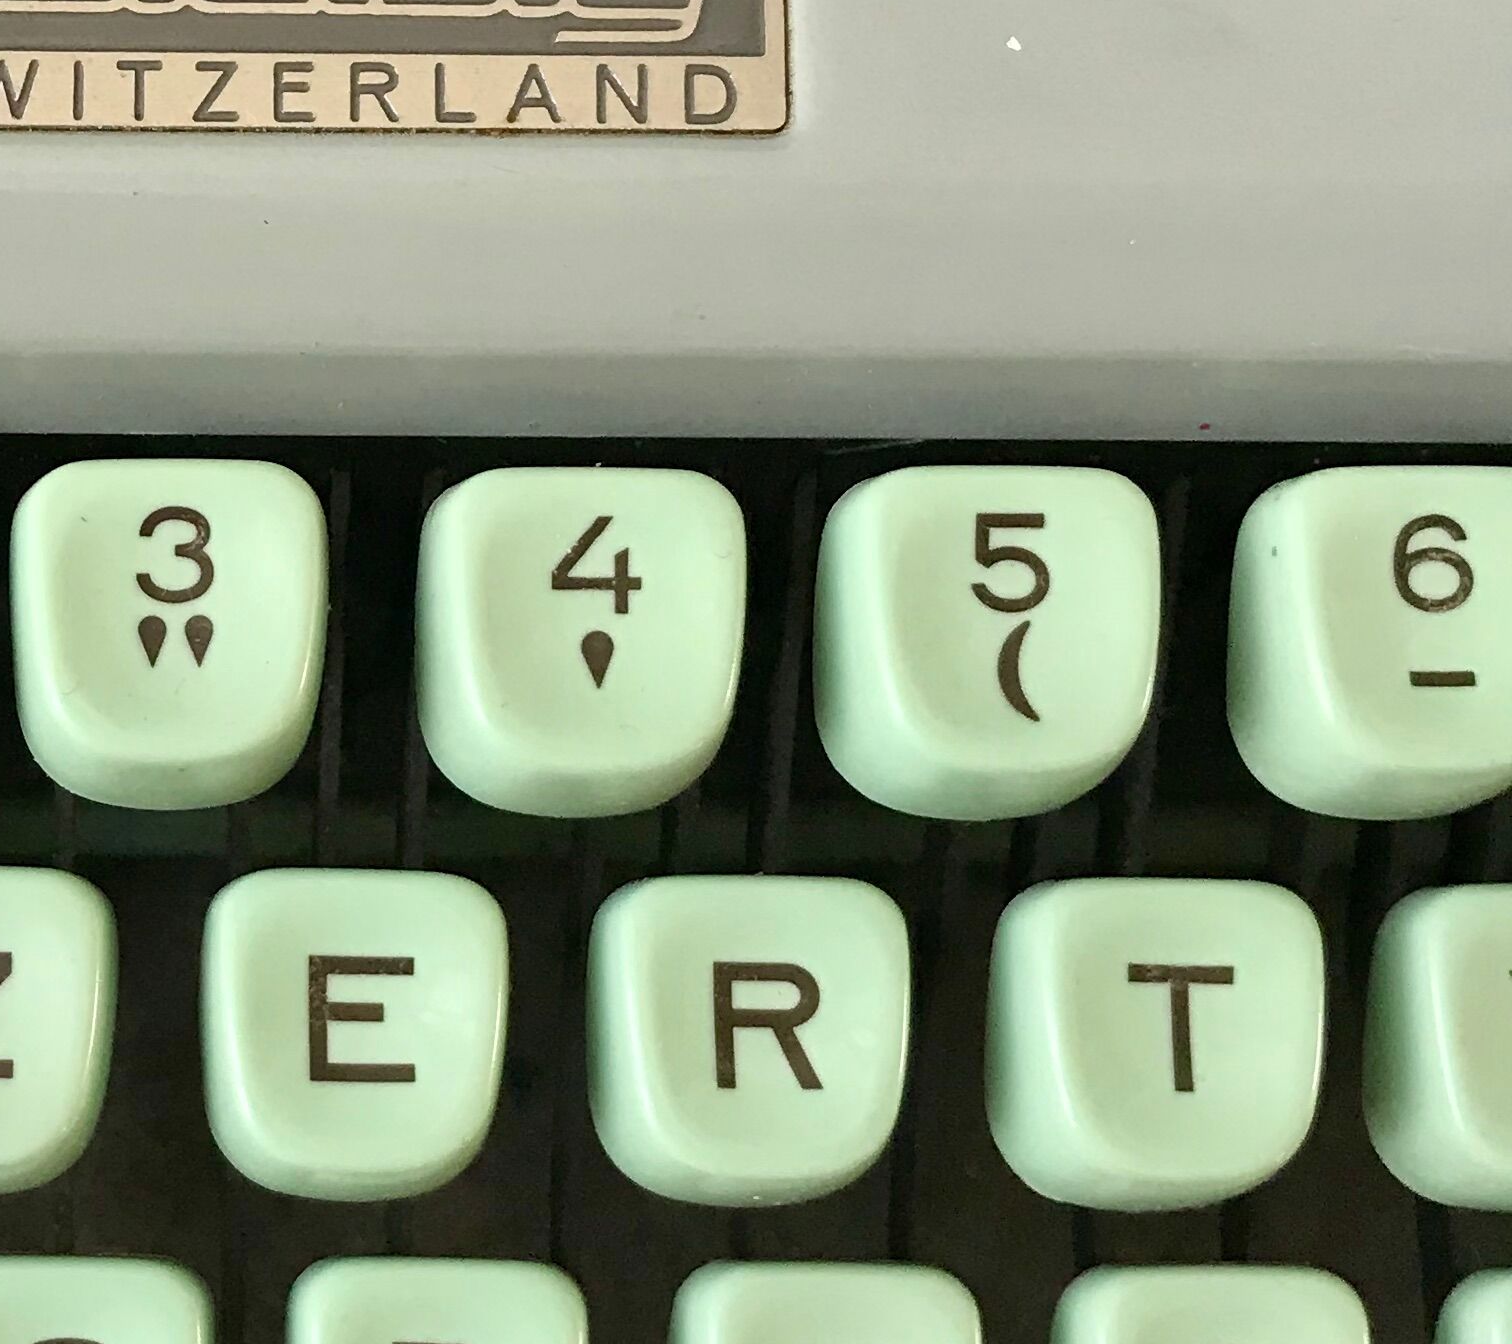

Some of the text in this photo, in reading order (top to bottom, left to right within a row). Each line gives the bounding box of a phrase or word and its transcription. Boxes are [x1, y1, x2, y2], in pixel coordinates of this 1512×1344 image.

[136, 506, 214, 604] 3
[552, 516, 641, 614] 4
[972, 513, 1049, 613] 5
[1394, 514, 1473, 613] 6
[308, 955, 416, 1083] E
[713, 962, 823, 1089] R
[1128, 963, 1234, 1092] T
